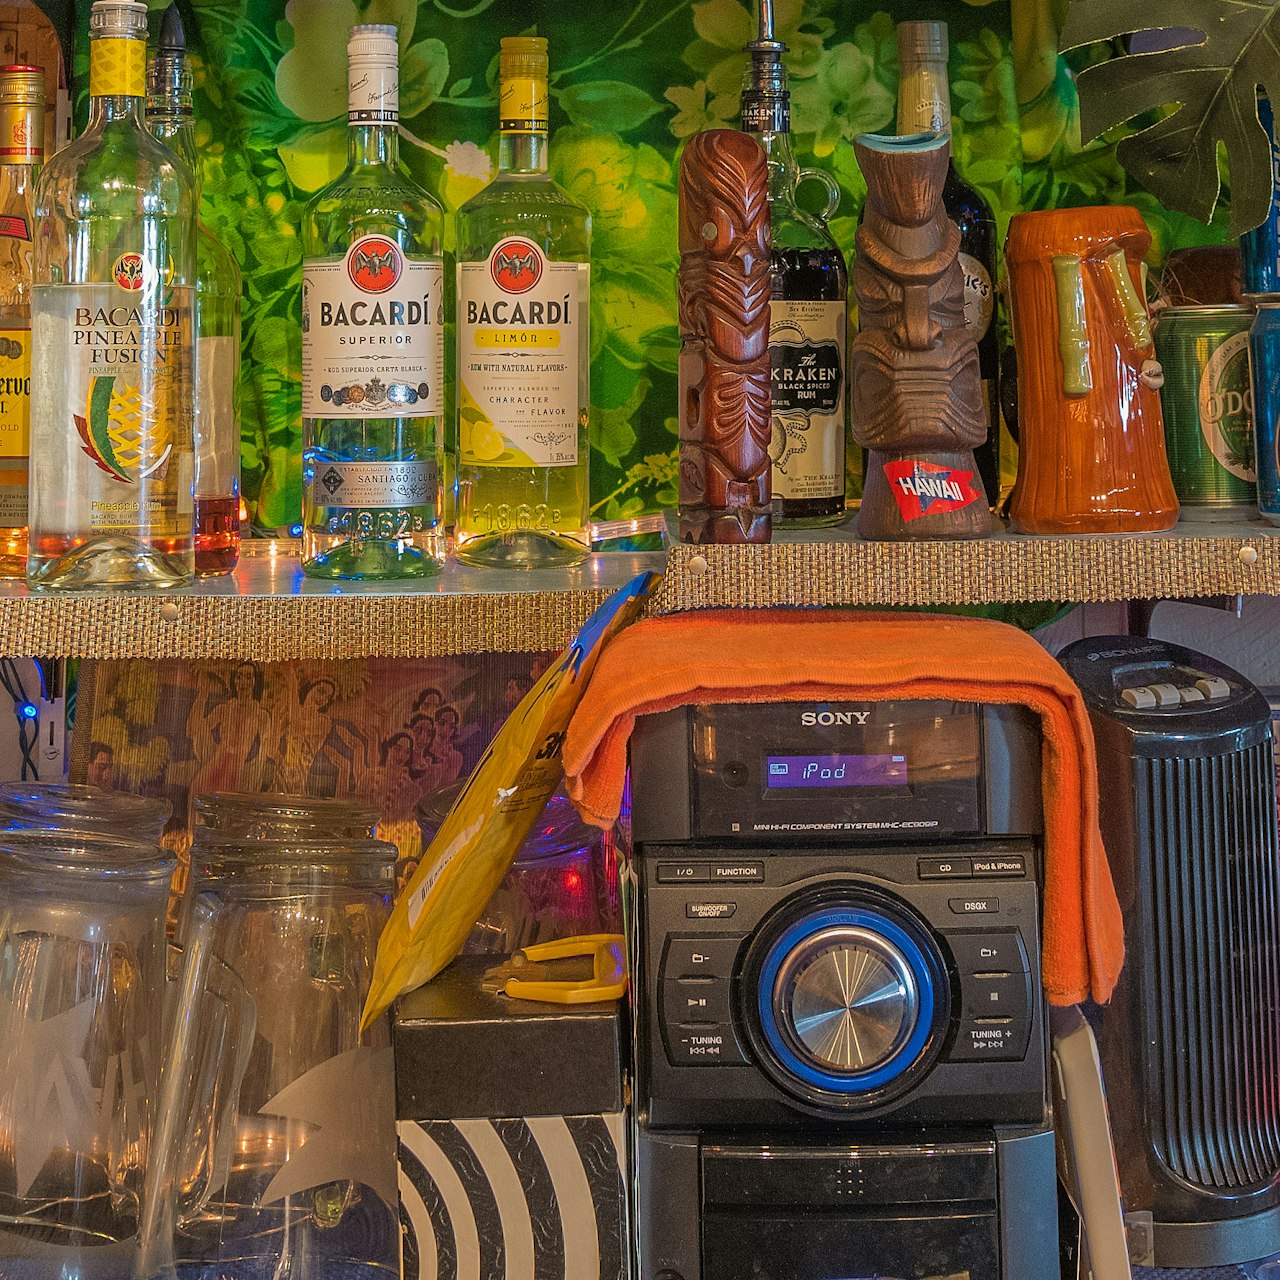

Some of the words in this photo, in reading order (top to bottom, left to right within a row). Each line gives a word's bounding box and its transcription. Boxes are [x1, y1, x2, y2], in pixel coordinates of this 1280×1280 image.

[321, 292, 429, 326] BACARDÍ
[468, 294, 570, 325] BACARDÍ
[74, 307, 180, 327] BACARDI
[73, 330, 181, 346] PINEAPPLE
[339, 336, 412, 345] SUPERIOR
[90, 349, 167, 364] FUSION
[798, 353, 817, 367] The
[770, 368, 836, 381] KRAKEN
[489, 396, 549, 404] CHARACTER
[797, 390, 817, 399] RUM
[531, 408, 566, 416] FLAVOR
[357, 474, 409, 483] SANTIAGO
[898, 475, 965, 502] HAWAII
[91, 501, 139, 513] Pineapple
[1099, 645, 1165, 659] BONAIRE
[801, 711, 870, 726] SONY
[801, 762, 845, 780] iPod
[753, 823, 770, 831] MINI
[770, 822, 790, 831] HI-FI
[790, 822, 843, 831] COMPONENT
[844, 822, 880, 830] SYSTEM
[716, 867, 757, 876] FUNCTION
[939, 863, 952, 872] CD
[964, 901, 987, 910] DSGX
[690, 1035, 722, 1045] TUNING
[971, 1029, 1004, 1039] TUNING
